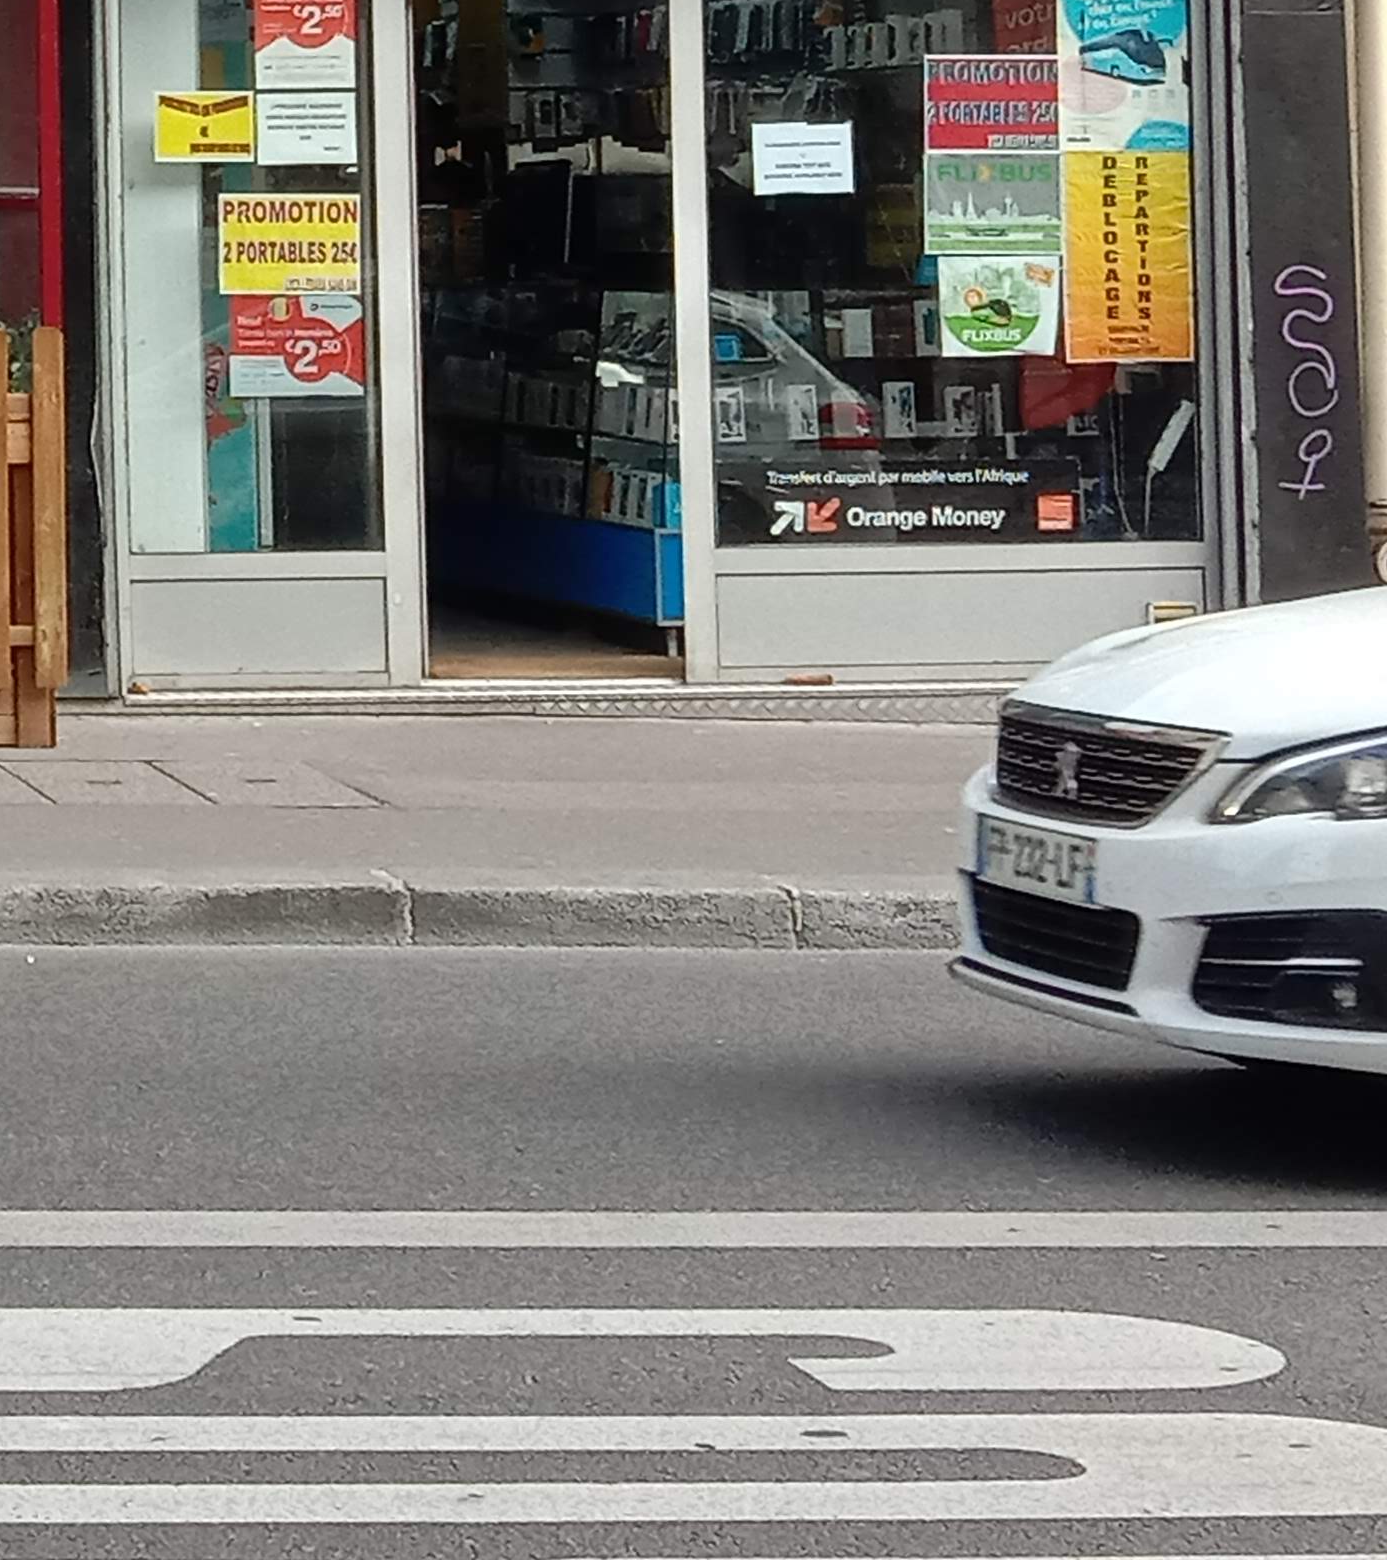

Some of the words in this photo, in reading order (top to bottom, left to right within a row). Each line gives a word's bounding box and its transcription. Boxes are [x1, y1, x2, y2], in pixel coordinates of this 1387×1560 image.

[222, 200, 358, 224] PROMOTION
[1101, 155, 1121, 321] DEBLOCAGE
[223, 241, 232, 264] 2
[236, 241, 327, 264] PORTABLES
[846, 506, 926, 531] Orange
[931, 505, 1006, 529] Money
